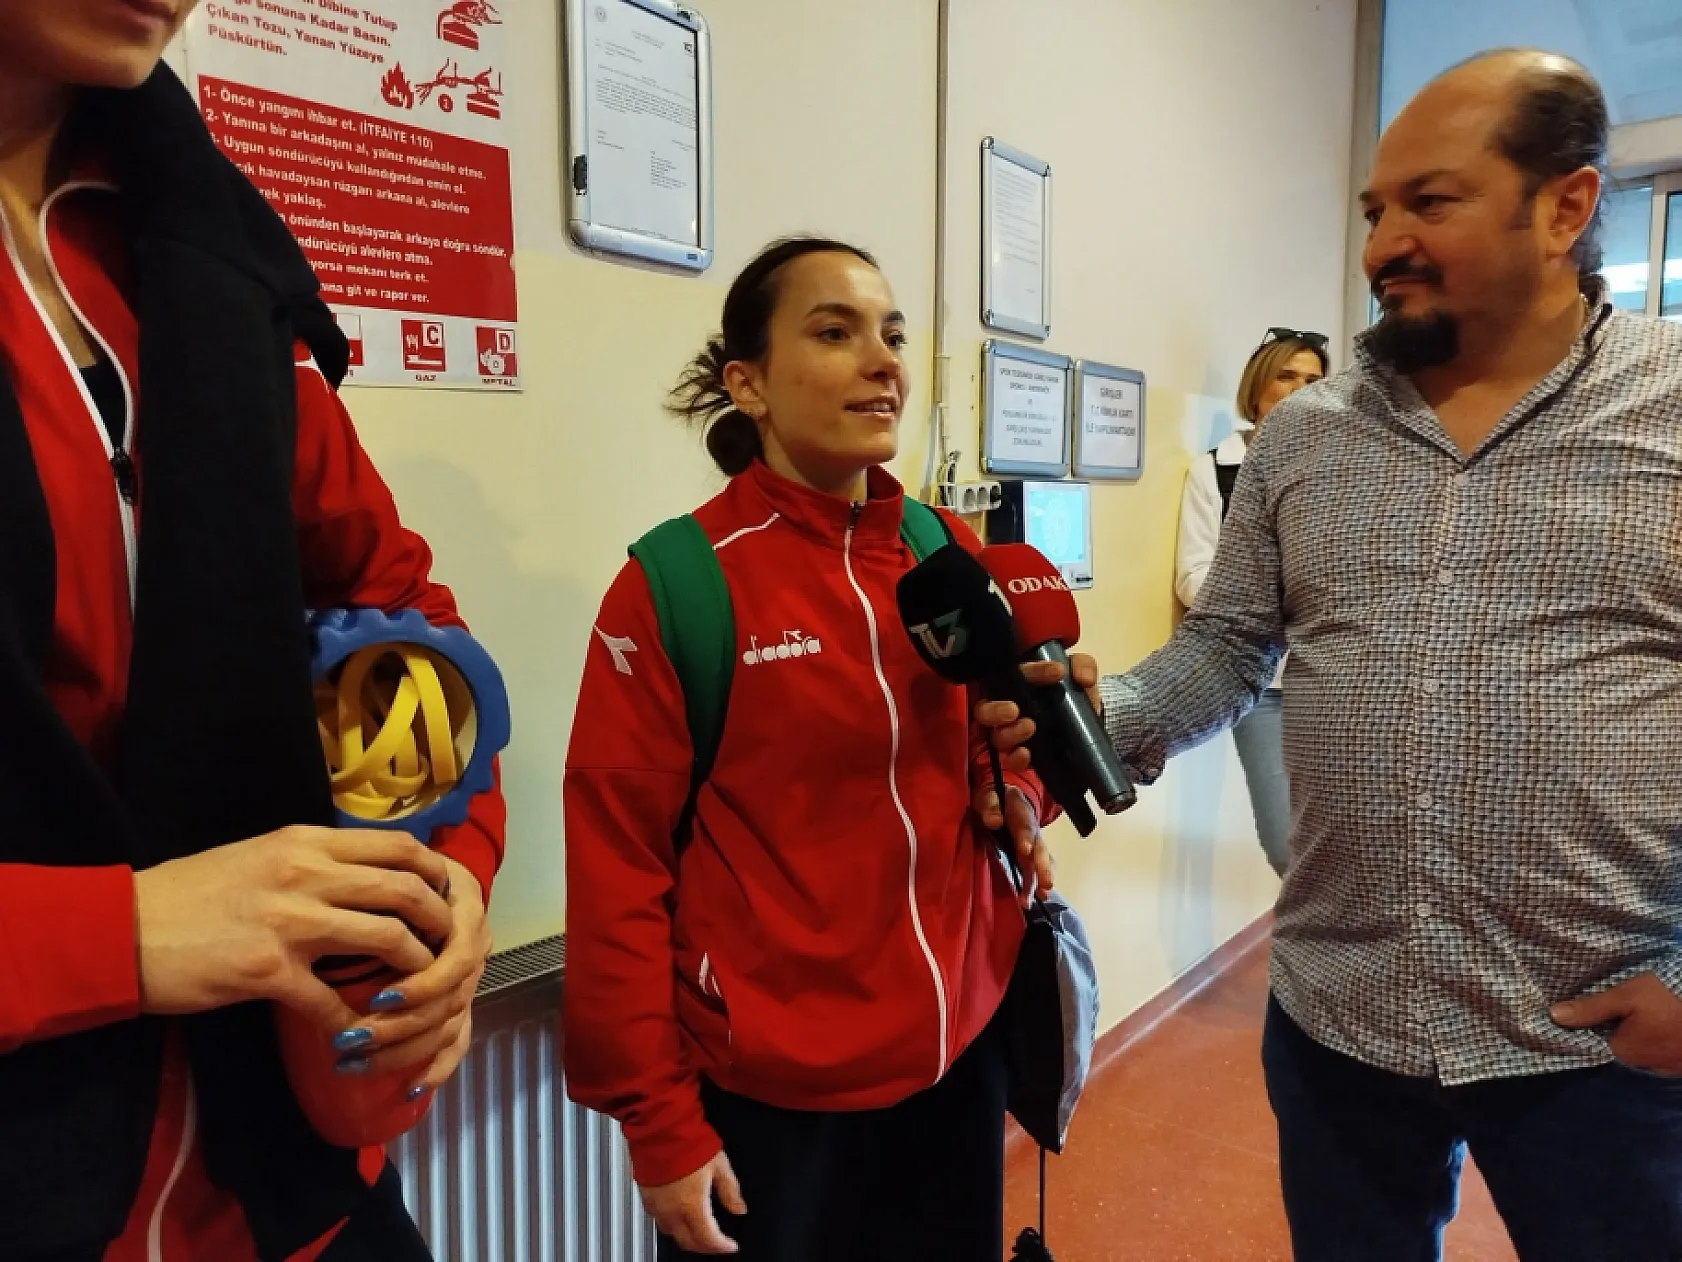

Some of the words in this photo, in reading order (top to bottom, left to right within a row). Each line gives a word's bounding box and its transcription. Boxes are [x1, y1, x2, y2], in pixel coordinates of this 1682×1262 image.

[206, 3, 249, 25] Çıkan
[295, 28, 335, 50] Yanan
[340, 40, 383, 63] Yüzeye
[311, 12, 349, 34] Kadar
[203, 84, 217, 98] 1-
[220, 84, 255, 108] Önce
[205, 108, 219, 122] 2-
[222, 111, 267, 133] Yanına
[270, 121, 288, 137] bir
[290, 127, 353, 152] arkadaşını
[223, 134, 265, 155] Uygun
[258, 163, 331, 188] havadaysan
[283, 192, 326, 210] yaklaş.
[289, 211, 340, 232] önünden
[293, 233, 358, 257] ndürücüyü
[364, 286, 378, 297] ve
[426, 324, 439, 345] C
[499, 331, 511, 352] D
[742, 629, 822, 666] diadora
